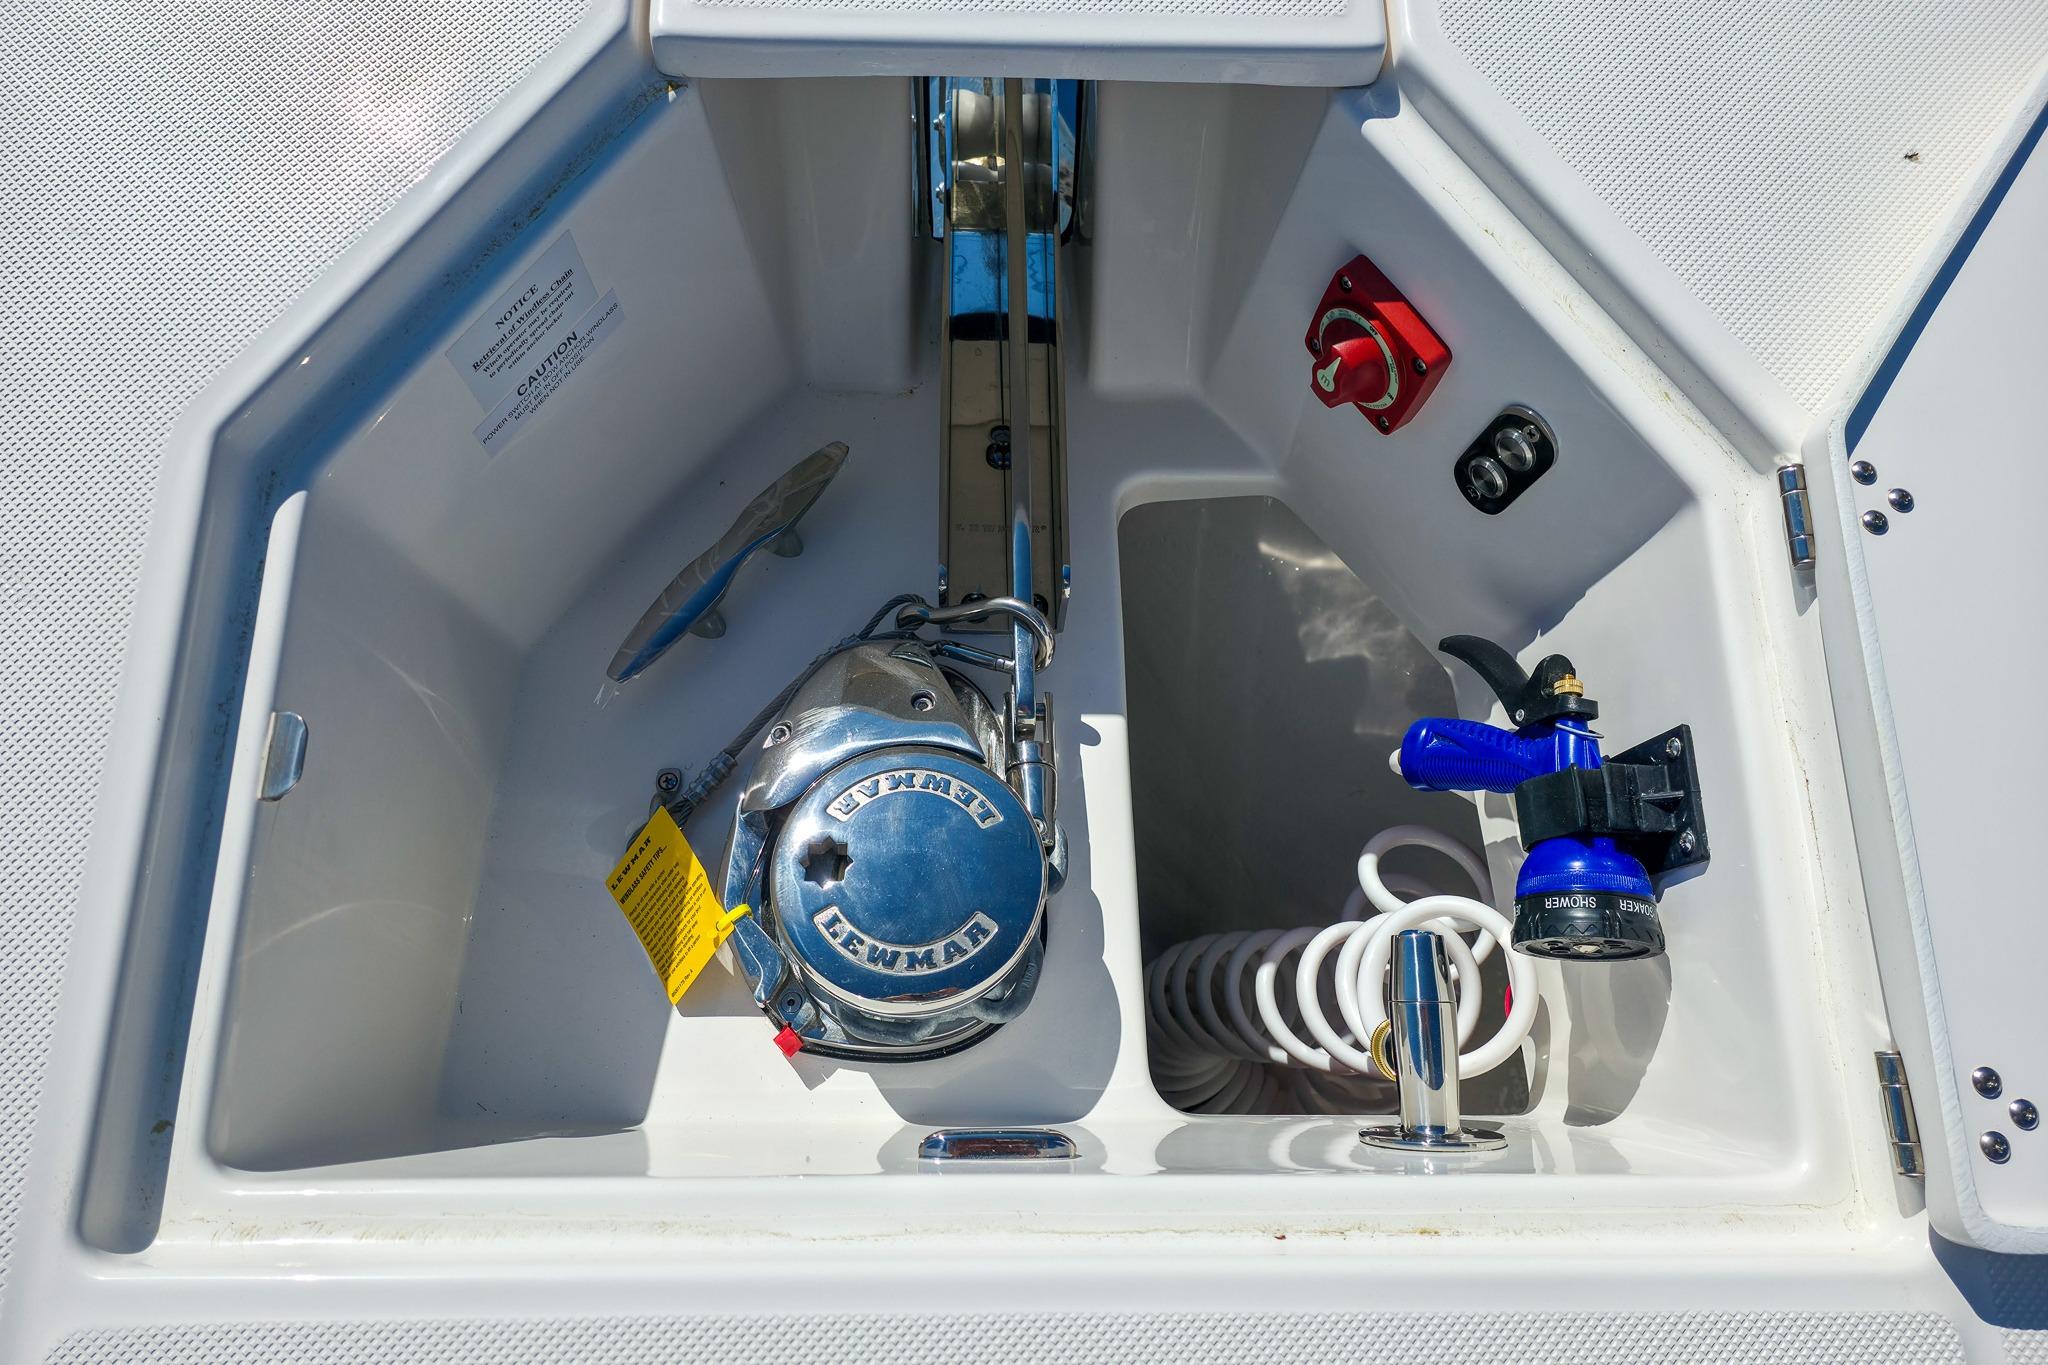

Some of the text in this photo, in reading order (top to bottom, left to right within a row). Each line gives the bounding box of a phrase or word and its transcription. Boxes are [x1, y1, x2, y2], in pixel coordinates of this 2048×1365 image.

[472, 267, 573, 372] Retrieval of Windless Chain
[496, 284, 539, 330] NOTICE
[483, 303, 618, 445] POWER SWITCH AT BOW ANCHOR WINDLASS
[515, 400, 535, 422] MUST
[534, 389, 544, 402] BE
[551, 368, 565, 384] OFF
[565, 337, 595, 370] POSITION
[516, 331, 578, 398] CAUTION
[530, 392, 550, 415] WHEN
[550, 378, 564, 394] NOT
[572, 355, 585, 371] USE
[834, 772, 996, 822] LEWMAR
[611, 837, 652, 890] LEWMAR
[619, 877, 640, 905] WINDLASS
[638, 857, 654, 880] SAFETY
[1544, 896, 1597, 909] SHOWER
[1619, 899, 1656, 921] SOAKER
[820, 912, 991, 971] LEWMAR
